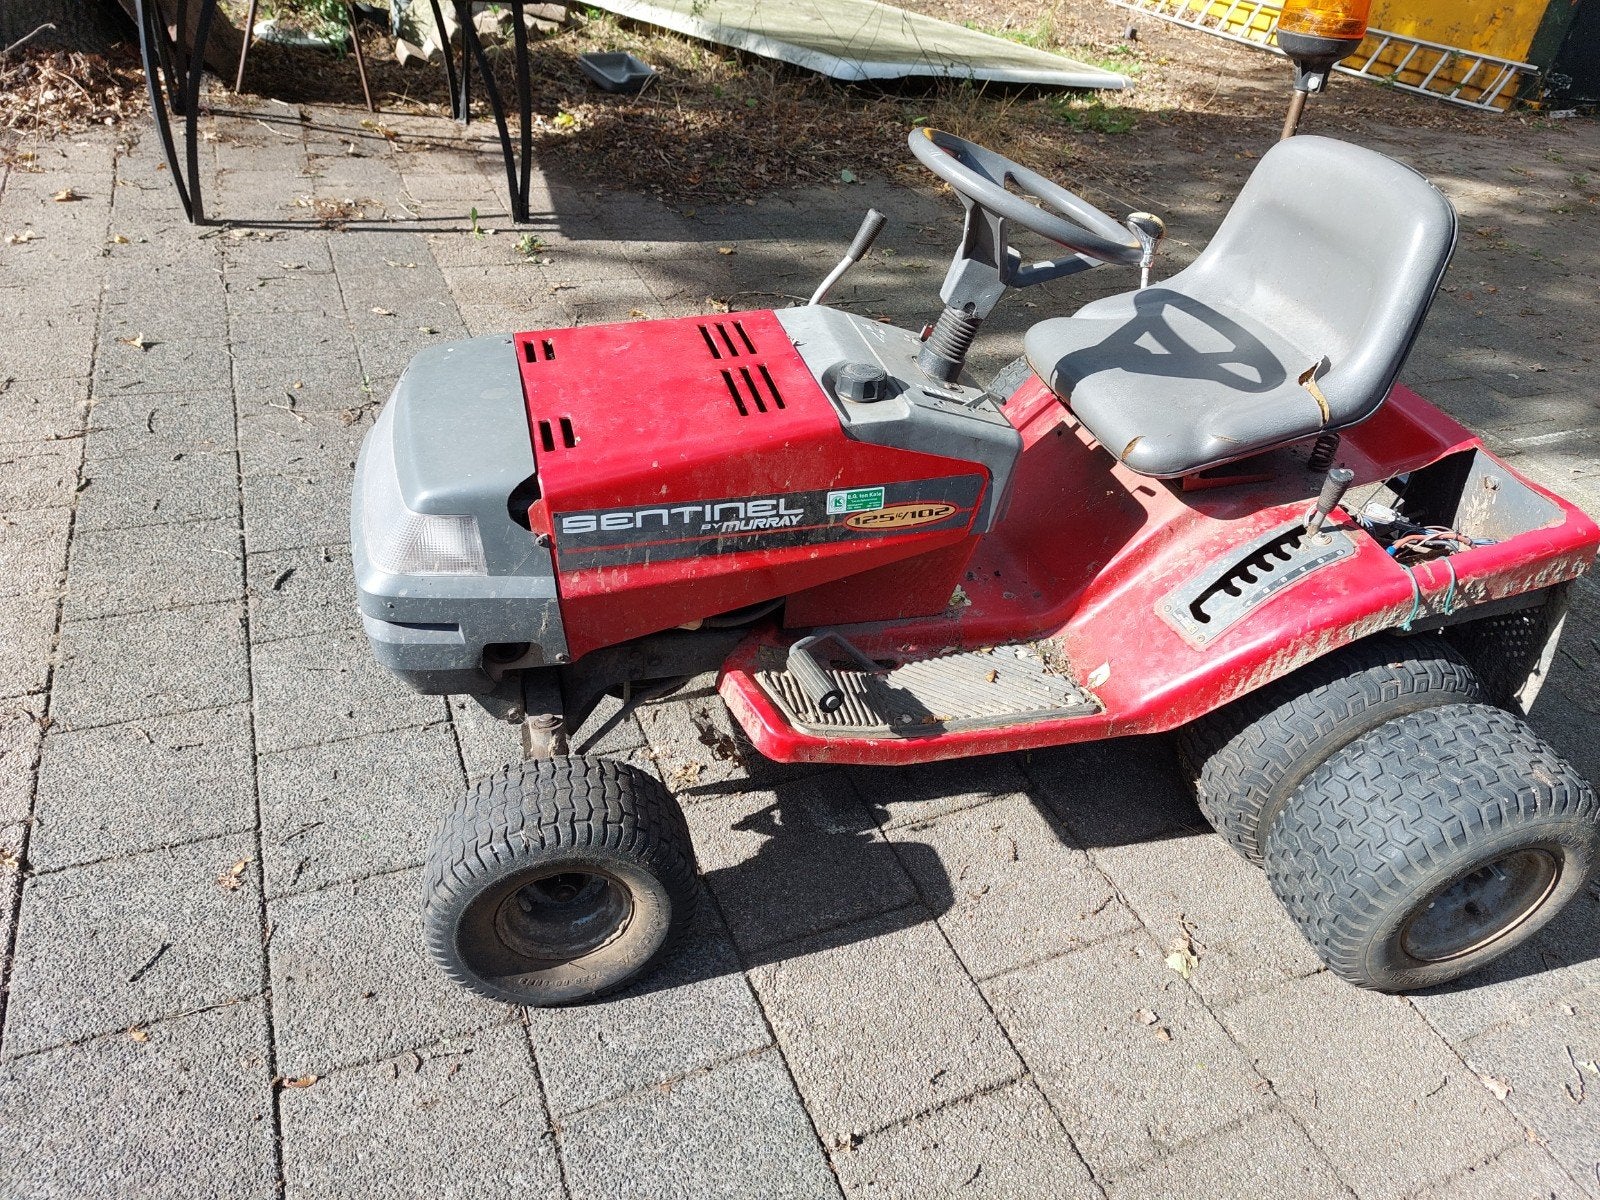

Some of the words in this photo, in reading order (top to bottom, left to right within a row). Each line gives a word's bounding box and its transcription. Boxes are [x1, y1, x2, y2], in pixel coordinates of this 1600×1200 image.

[562, 498, 804, 534] SENTINEL
[700, 522, 723, 531] BY
[721, 514, 804, 533] MURRAY
